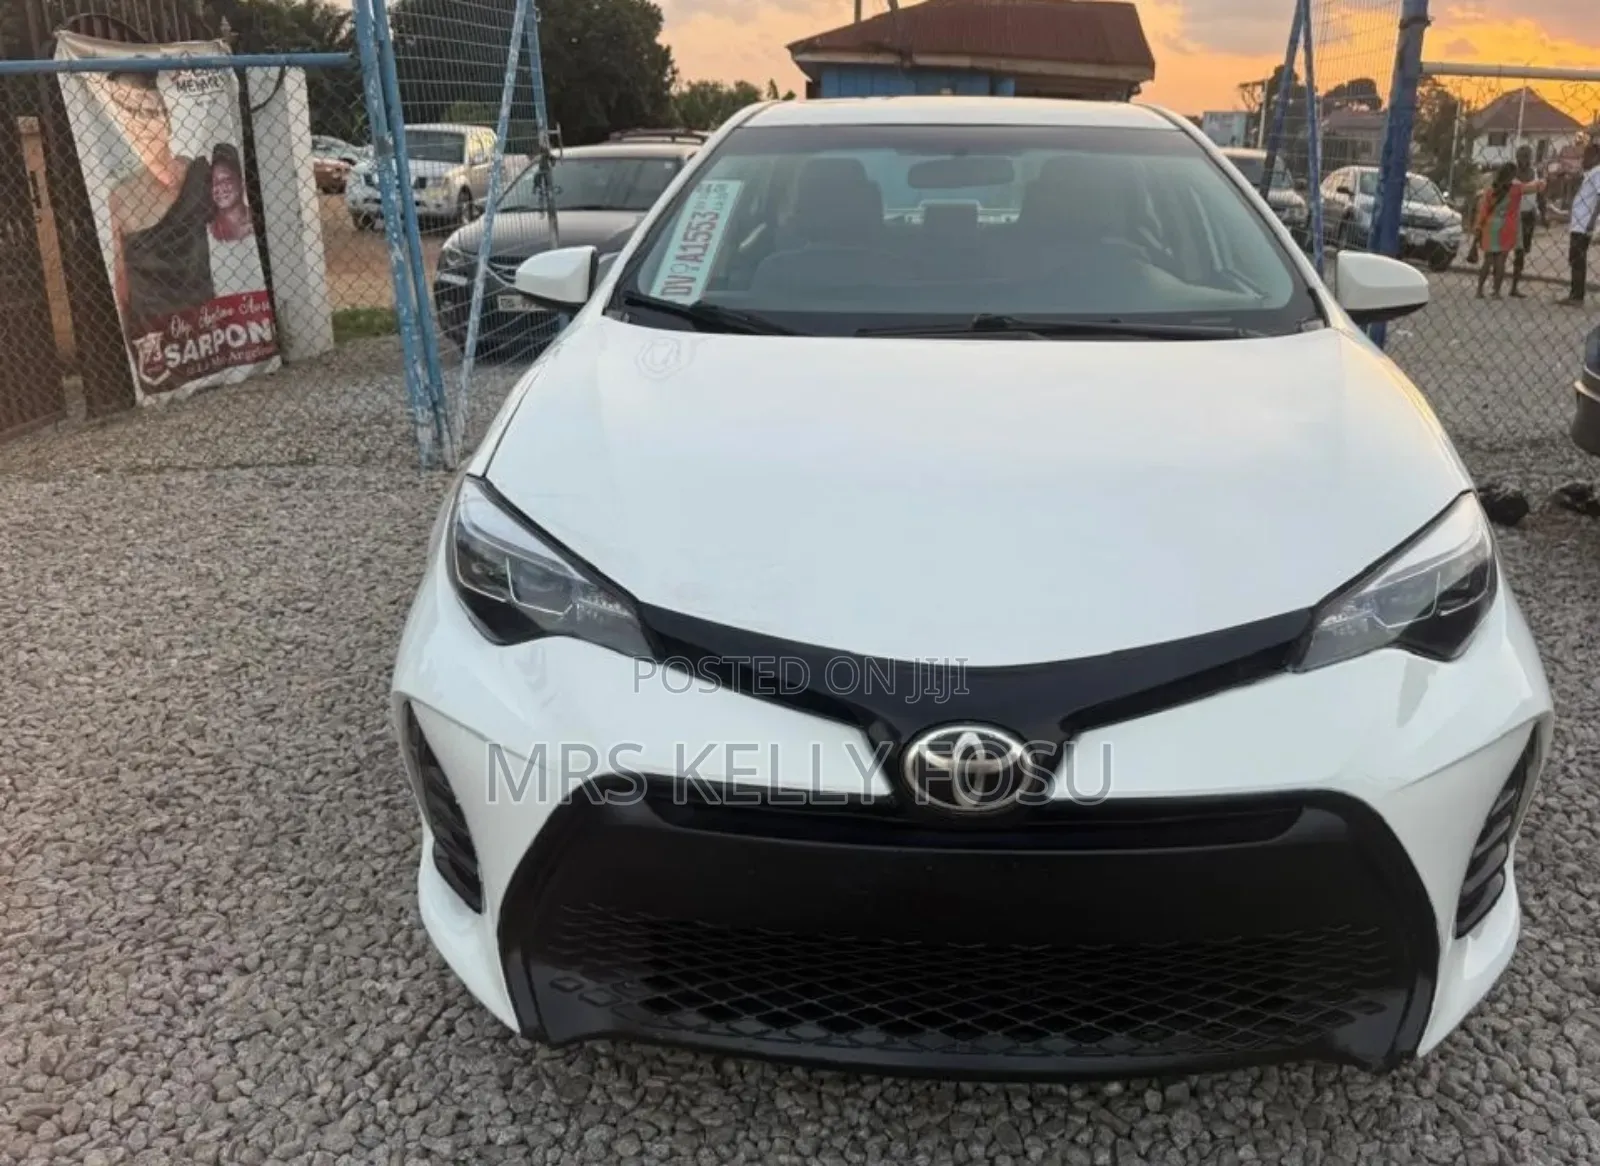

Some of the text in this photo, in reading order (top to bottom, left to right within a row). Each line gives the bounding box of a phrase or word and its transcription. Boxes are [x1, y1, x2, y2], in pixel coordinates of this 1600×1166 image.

[675, 211, 720, 263] A1553
[661, 275, 697, 297] DV
[163, 318, 277, 369] SARPON
